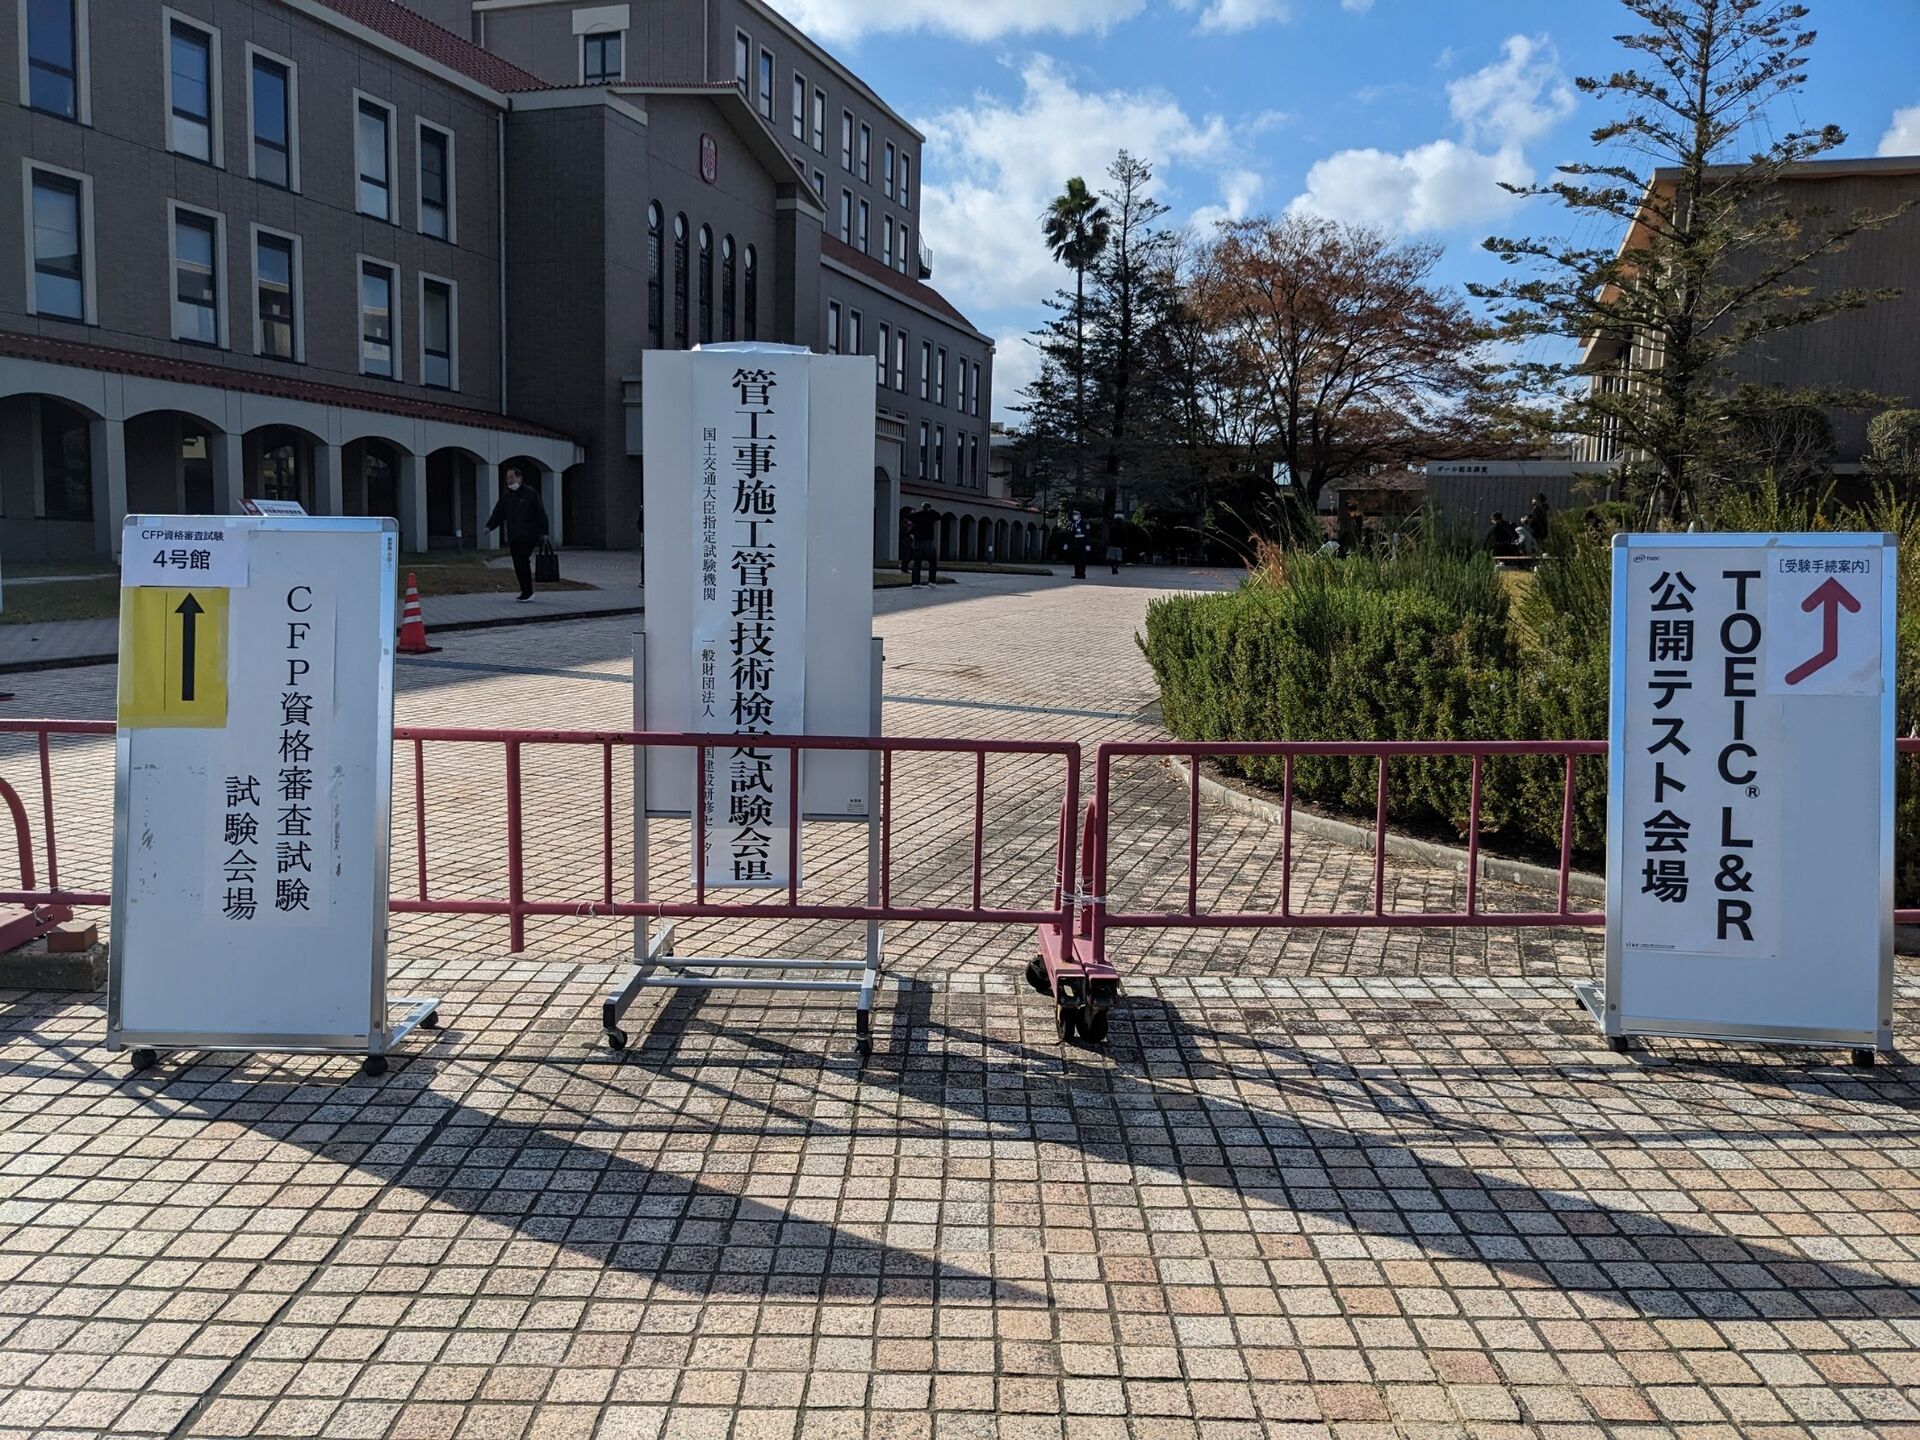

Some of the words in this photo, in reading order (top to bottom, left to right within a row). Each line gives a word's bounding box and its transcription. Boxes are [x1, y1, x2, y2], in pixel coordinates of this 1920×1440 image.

[141, 530, 224, 542] CFP資格審査試験
[152, 549, 211, 570] 4号館
[702, 427, 717, 601] 国土交通大臣指定試験機関
[275, 585, 314, 912] CFP資格審査試験
[701, 639, 716, 718] 一般財団法人
[1641, 571, 1697, 903] 公開テスト会場
[222, 775, 261, 921] 試験会場
[702, 731, 715, 868] 国建設研修センター
